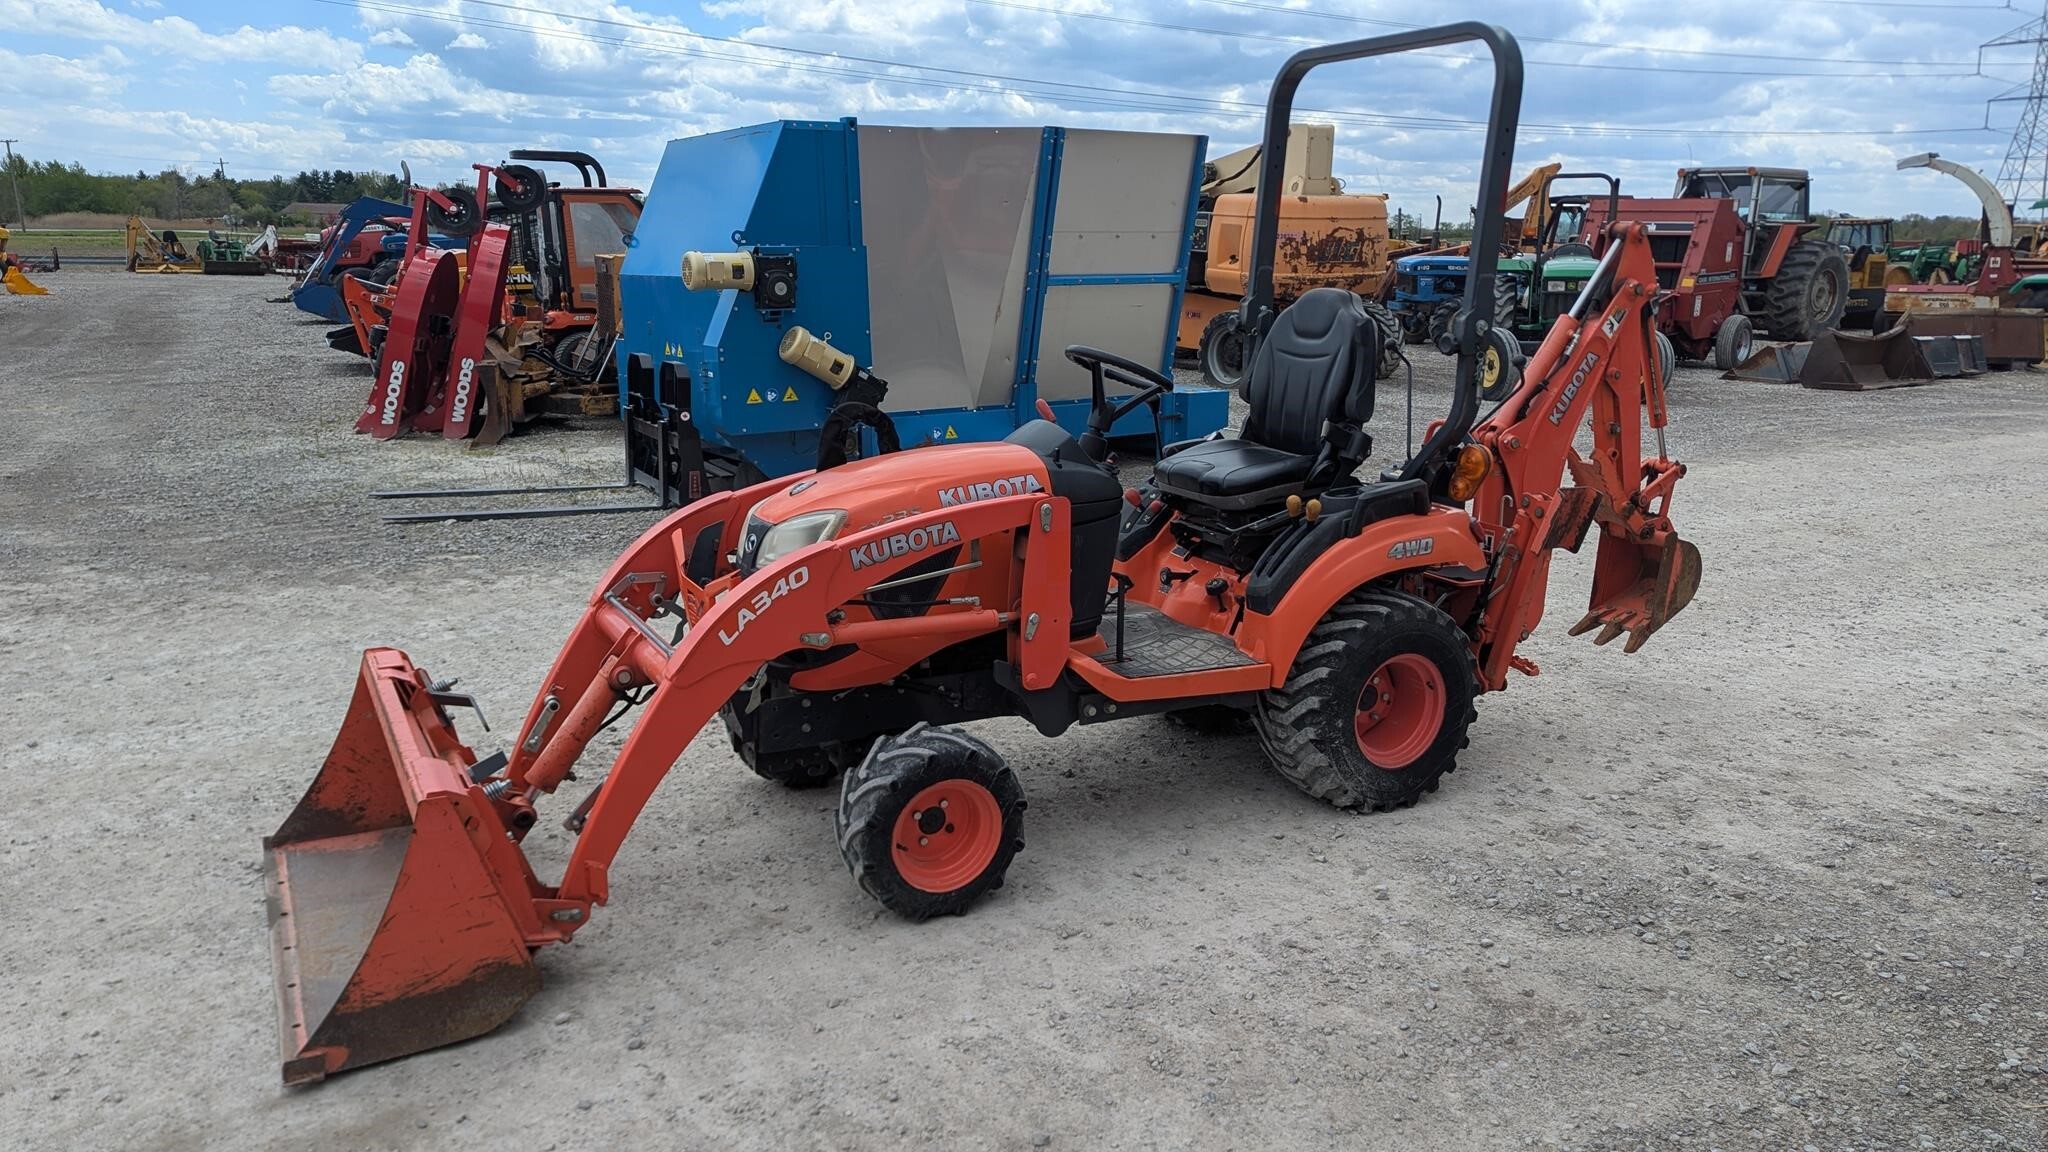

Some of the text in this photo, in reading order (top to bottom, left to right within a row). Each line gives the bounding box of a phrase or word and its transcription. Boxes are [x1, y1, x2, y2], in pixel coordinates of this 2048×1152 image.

[381, 360, 405, 425] WOODS
[451, 358, 475, 423] WOODS
[1548, 351, 1601, 427] KUBOTA
[937, 474, 1043, 508] KUBOTA
[850, 520, 962, 572] KUBOTA
[1387, 536, 1433, 559] 4WD
[718, 565, 810, 646] LA340
